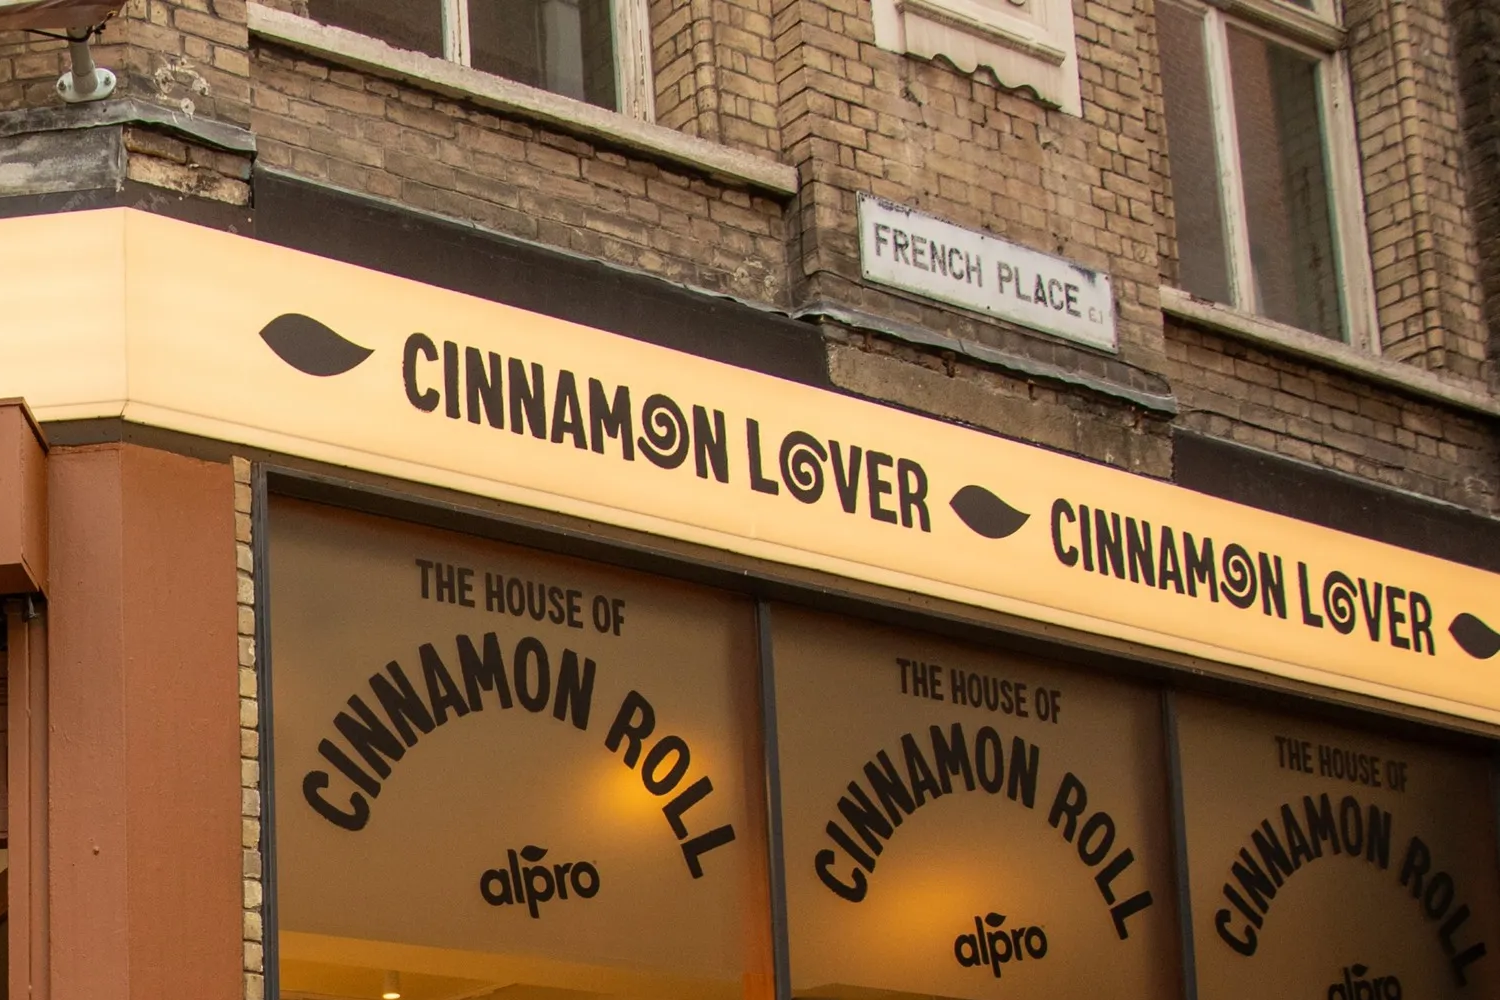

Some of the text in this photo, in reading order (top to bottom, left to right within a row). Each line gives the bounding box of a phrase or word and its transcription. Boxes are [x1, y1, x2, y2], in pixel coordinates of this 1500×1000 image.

[873, 222, 983, 288] FRENCH
[997, 260, 1081, 318] PLACE
[402, 332, 931, 533] CINNAMON LOVER
[415, 559, 627, 636] THE HOUSE OF
[1050, 498, 1436, 656] CINNAMON LOVER
[896, 657, 1062, 725] THE HOUSE OF
[302, 631, 736, 879] CINNAMON ROLL
[1274, 736, 1409, 793] THE HOUSE OF
[814, 722, 1153, 941] CINNAMON ROLL
[480, 845, 601, 919] alpro
[1215, 792, 1487, 987] CINNAMON ROLL
[954, 911, 1048, 978] alpro
